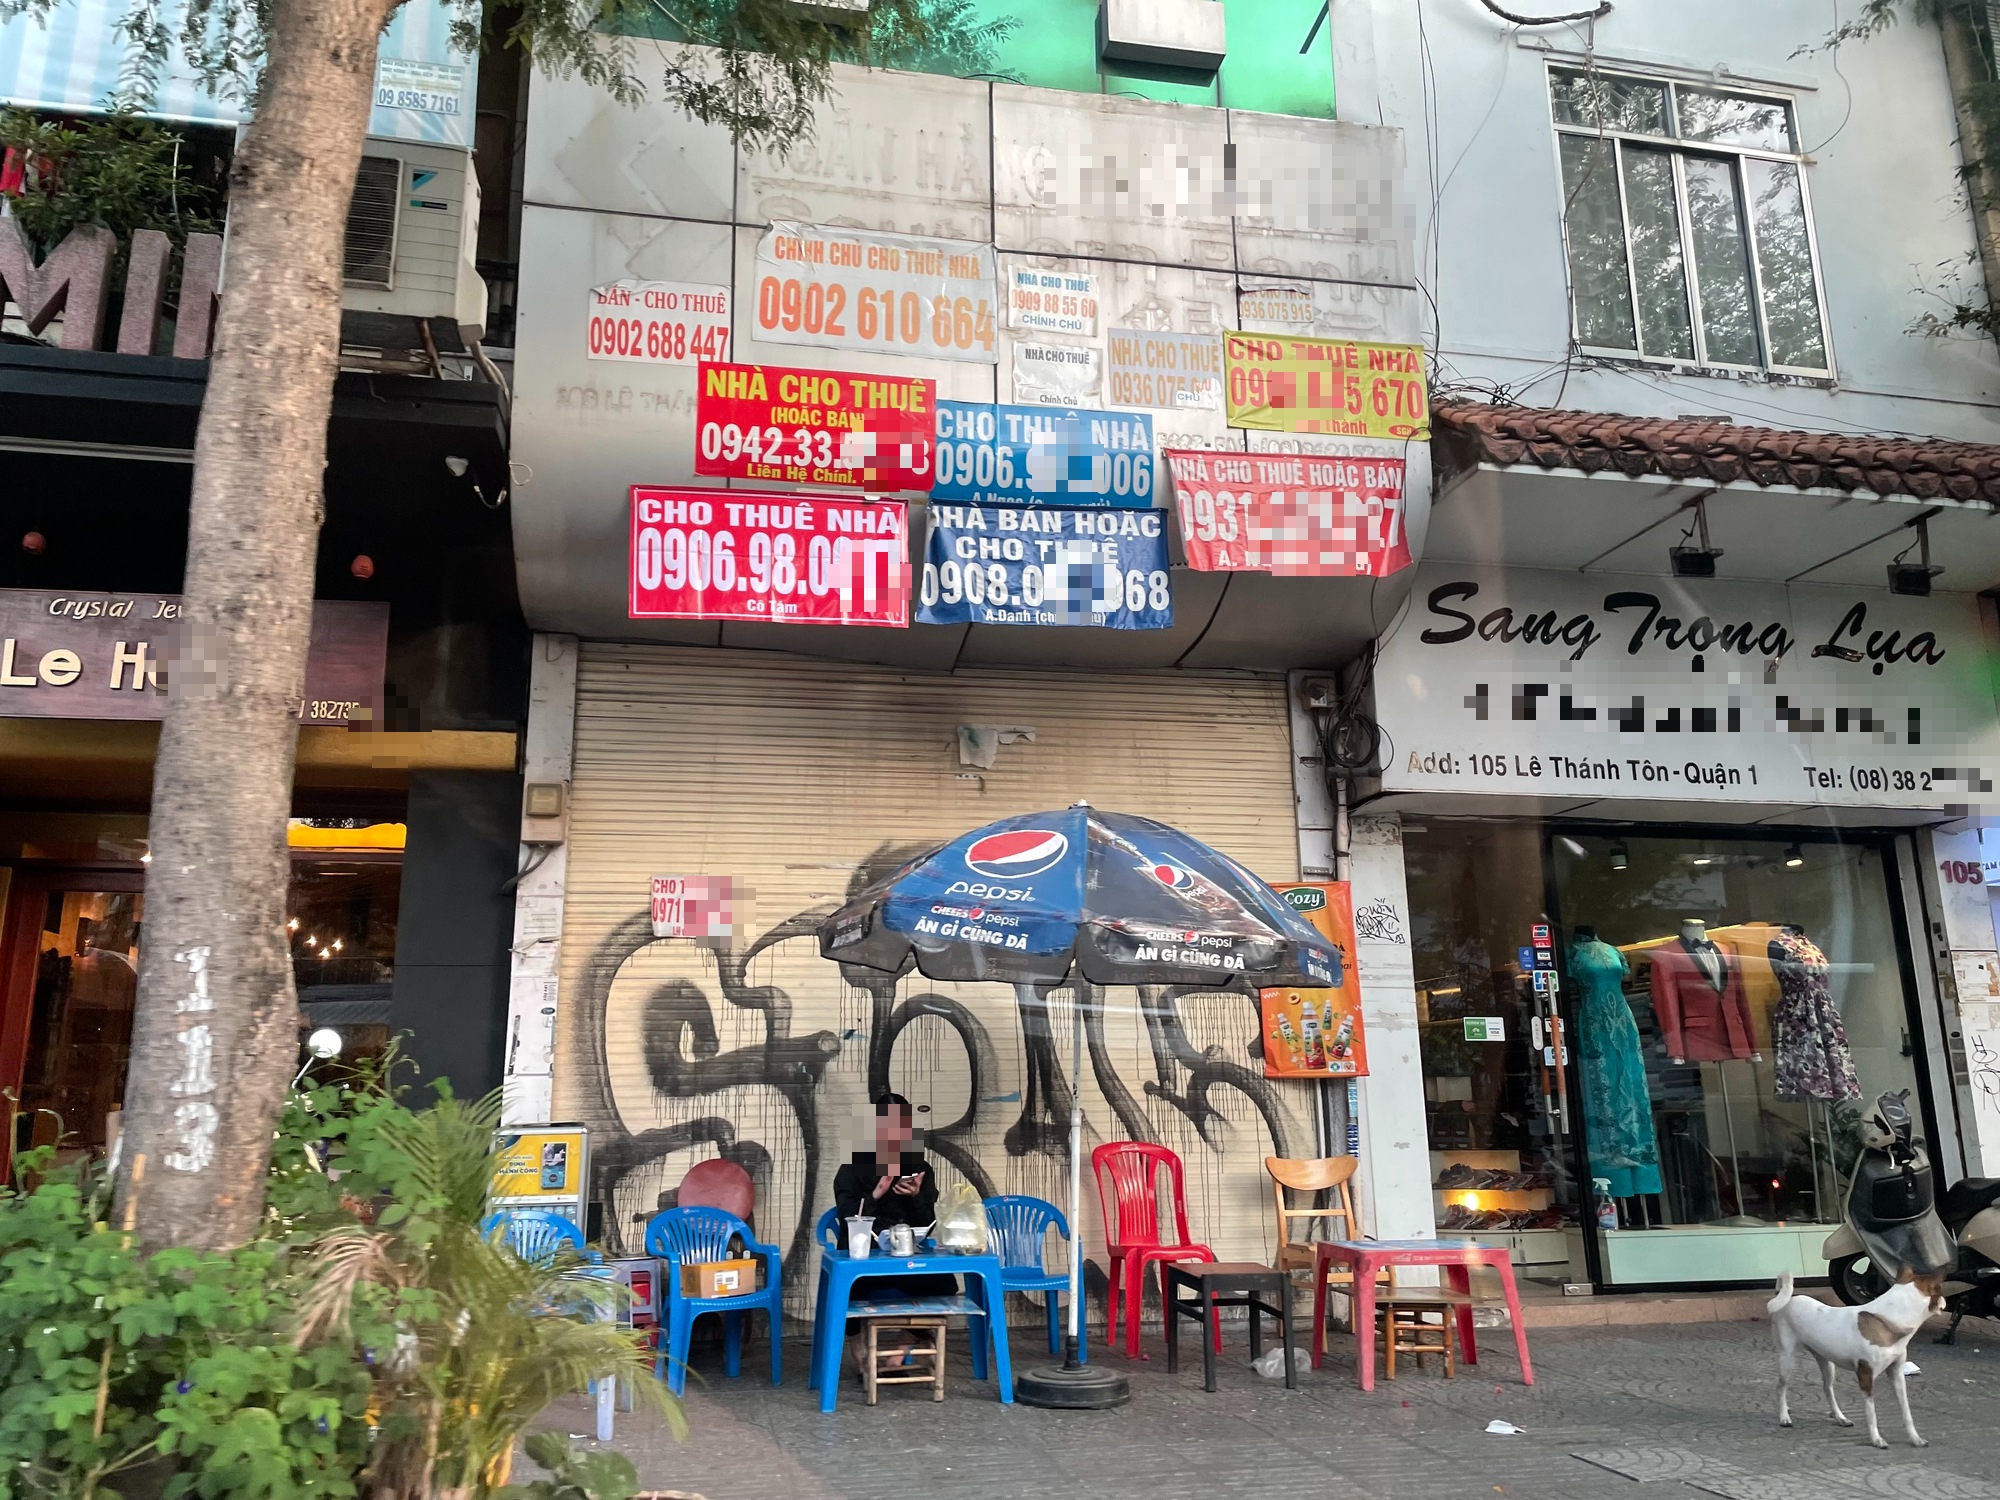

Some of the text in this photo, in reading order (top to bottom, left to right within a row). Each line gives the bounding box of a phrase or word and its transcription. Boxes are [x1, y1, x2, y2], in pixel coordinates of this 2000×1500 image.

[379, 88, 458, 113] 09 8585 7161
[868, 246, 900, 272] CHO
[1041, 276, 1062, 288] CHO
[1064, 278, 1090, 292] THUÊ
[644, 290, 678, 310] CHO
[682, 292, 726, 314] THUÊ
[760, 276, 994, 351] 0902 610 664
[1012, 290, 1096, 318] 0909 88 55 60
[1240, 301, 1265, 318] 0936
[1268, 302, 1289, 320] 075
[1290, 302, 1312, 320] 915
[1022, 314, 1056, 328] CHÍNH
[590, 316, 729, 362] 0902 688 447
[1025, 347, 1090, 364] NHÀ CHO THUÊ
[1112, 334, 1220, 373] NHÀ CHO THUÊ
[1228, 338, 1283, 362] CHO
[1368, 346, 1421, 374] NHÀ
[706, 366, 926, 413] NHÀ CHO THUÊ
[1040, 394, 1062, 404] Chính
[1112, 371, 1152, 405] 0936
[1372, 378, 1424, 420] 670
[770, 406, 822, 430] (HOẶC
[936, 408, 995, 442] CHO
[1091, 415, 1149, 450] NHÀ
[747, 463, 781, 480] Liên
[786, 466, 807, 483] Hệ
[1169, 454, 1402, 492] NHÀ CHO THUÊ HOẶC BÁN
[638, 498, 900, 534] CHO THUÊ NHÀ
[998, 504, 1062, 534] BÁN
[1074, 510, 1161, 541] HOẶC
[956, 536, 1024, 561] CHO
[746, 599, 797, 614] Cô Tám
[1420, 582, 1946, 676] Sang Trọng Lụa
[0, 638, 83, 687] Le
[1407, 751, 1460, 775] Add:
[1468, 754, 1508, 776] 105
[1515, 755, 1542, 778] Lê
[1549, 756, 1620, 780] Thánh
[1748, 765, 1758, 785] 1
[1804, 766, 1843, 788] Tel:
[1850, 766, 1889, 792] (08)
[1940, 860, 1984, 884] 105
[652, 879, 676, 894] CHO
[944, 881, 1032, 902] pepsi
[1284, 892, 1320, 907] Cozy
[986, 914, 1020, 927] pepsi
[960, 926, 1004, 945] CŨNG
[1146, 931, 1232, 948] CHEERS pepsi
[1180, 948, 1221, 967] CŨNG
